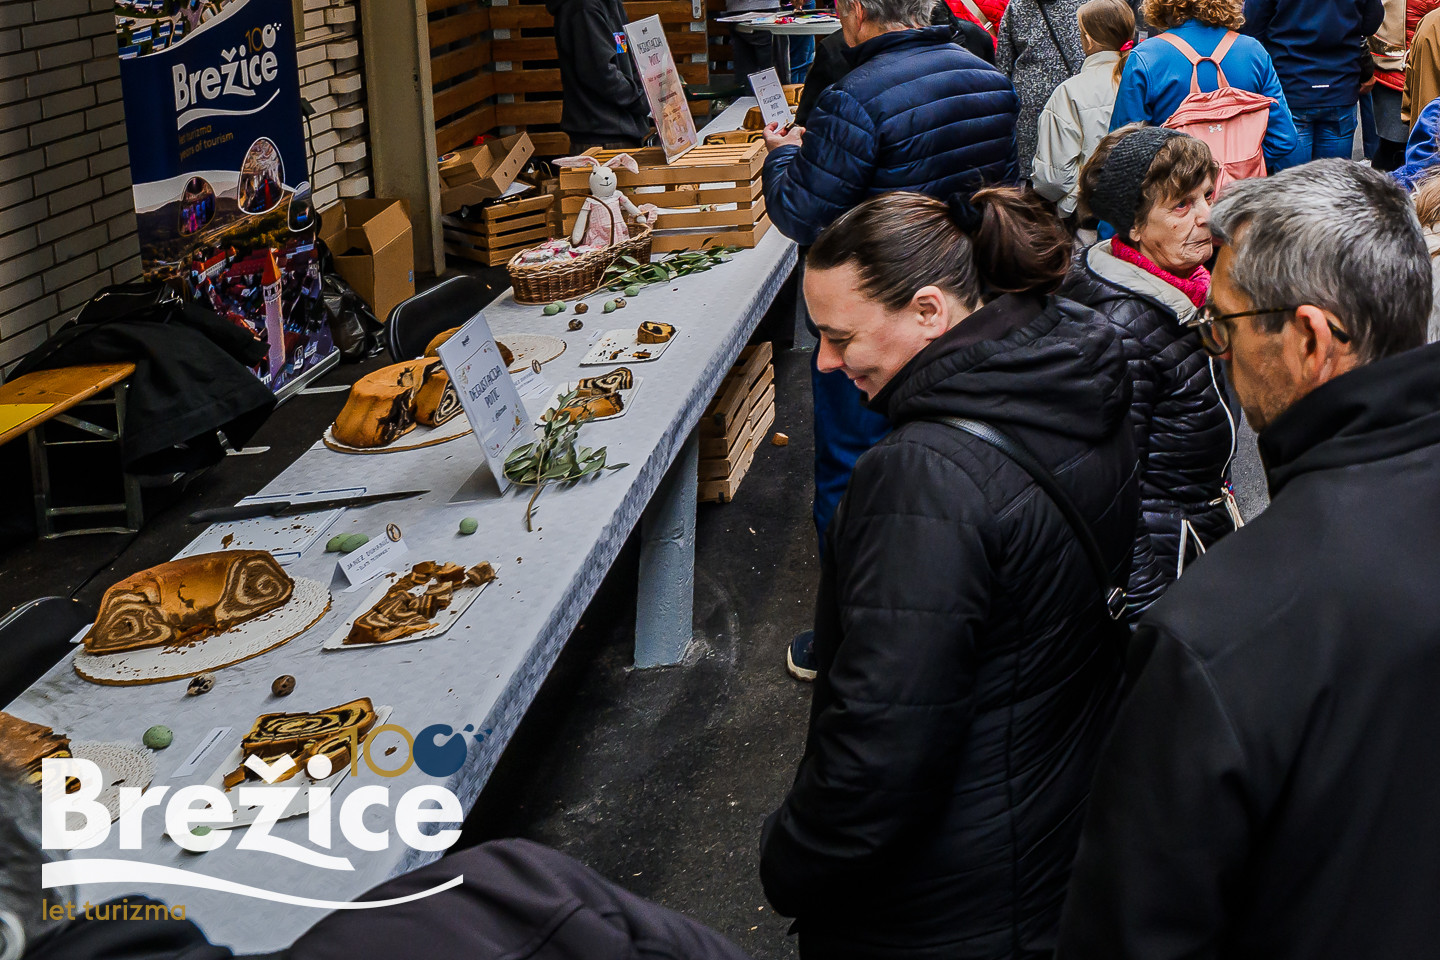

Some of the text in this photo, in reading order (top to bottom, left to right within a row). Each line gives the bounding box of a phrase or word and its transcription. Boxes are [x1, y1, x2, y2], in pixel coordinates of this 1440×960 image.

[172, 44, 278, 112] Brežice
[195, 140, 202, 152] of
[203, 132, 234, 149] tourism
